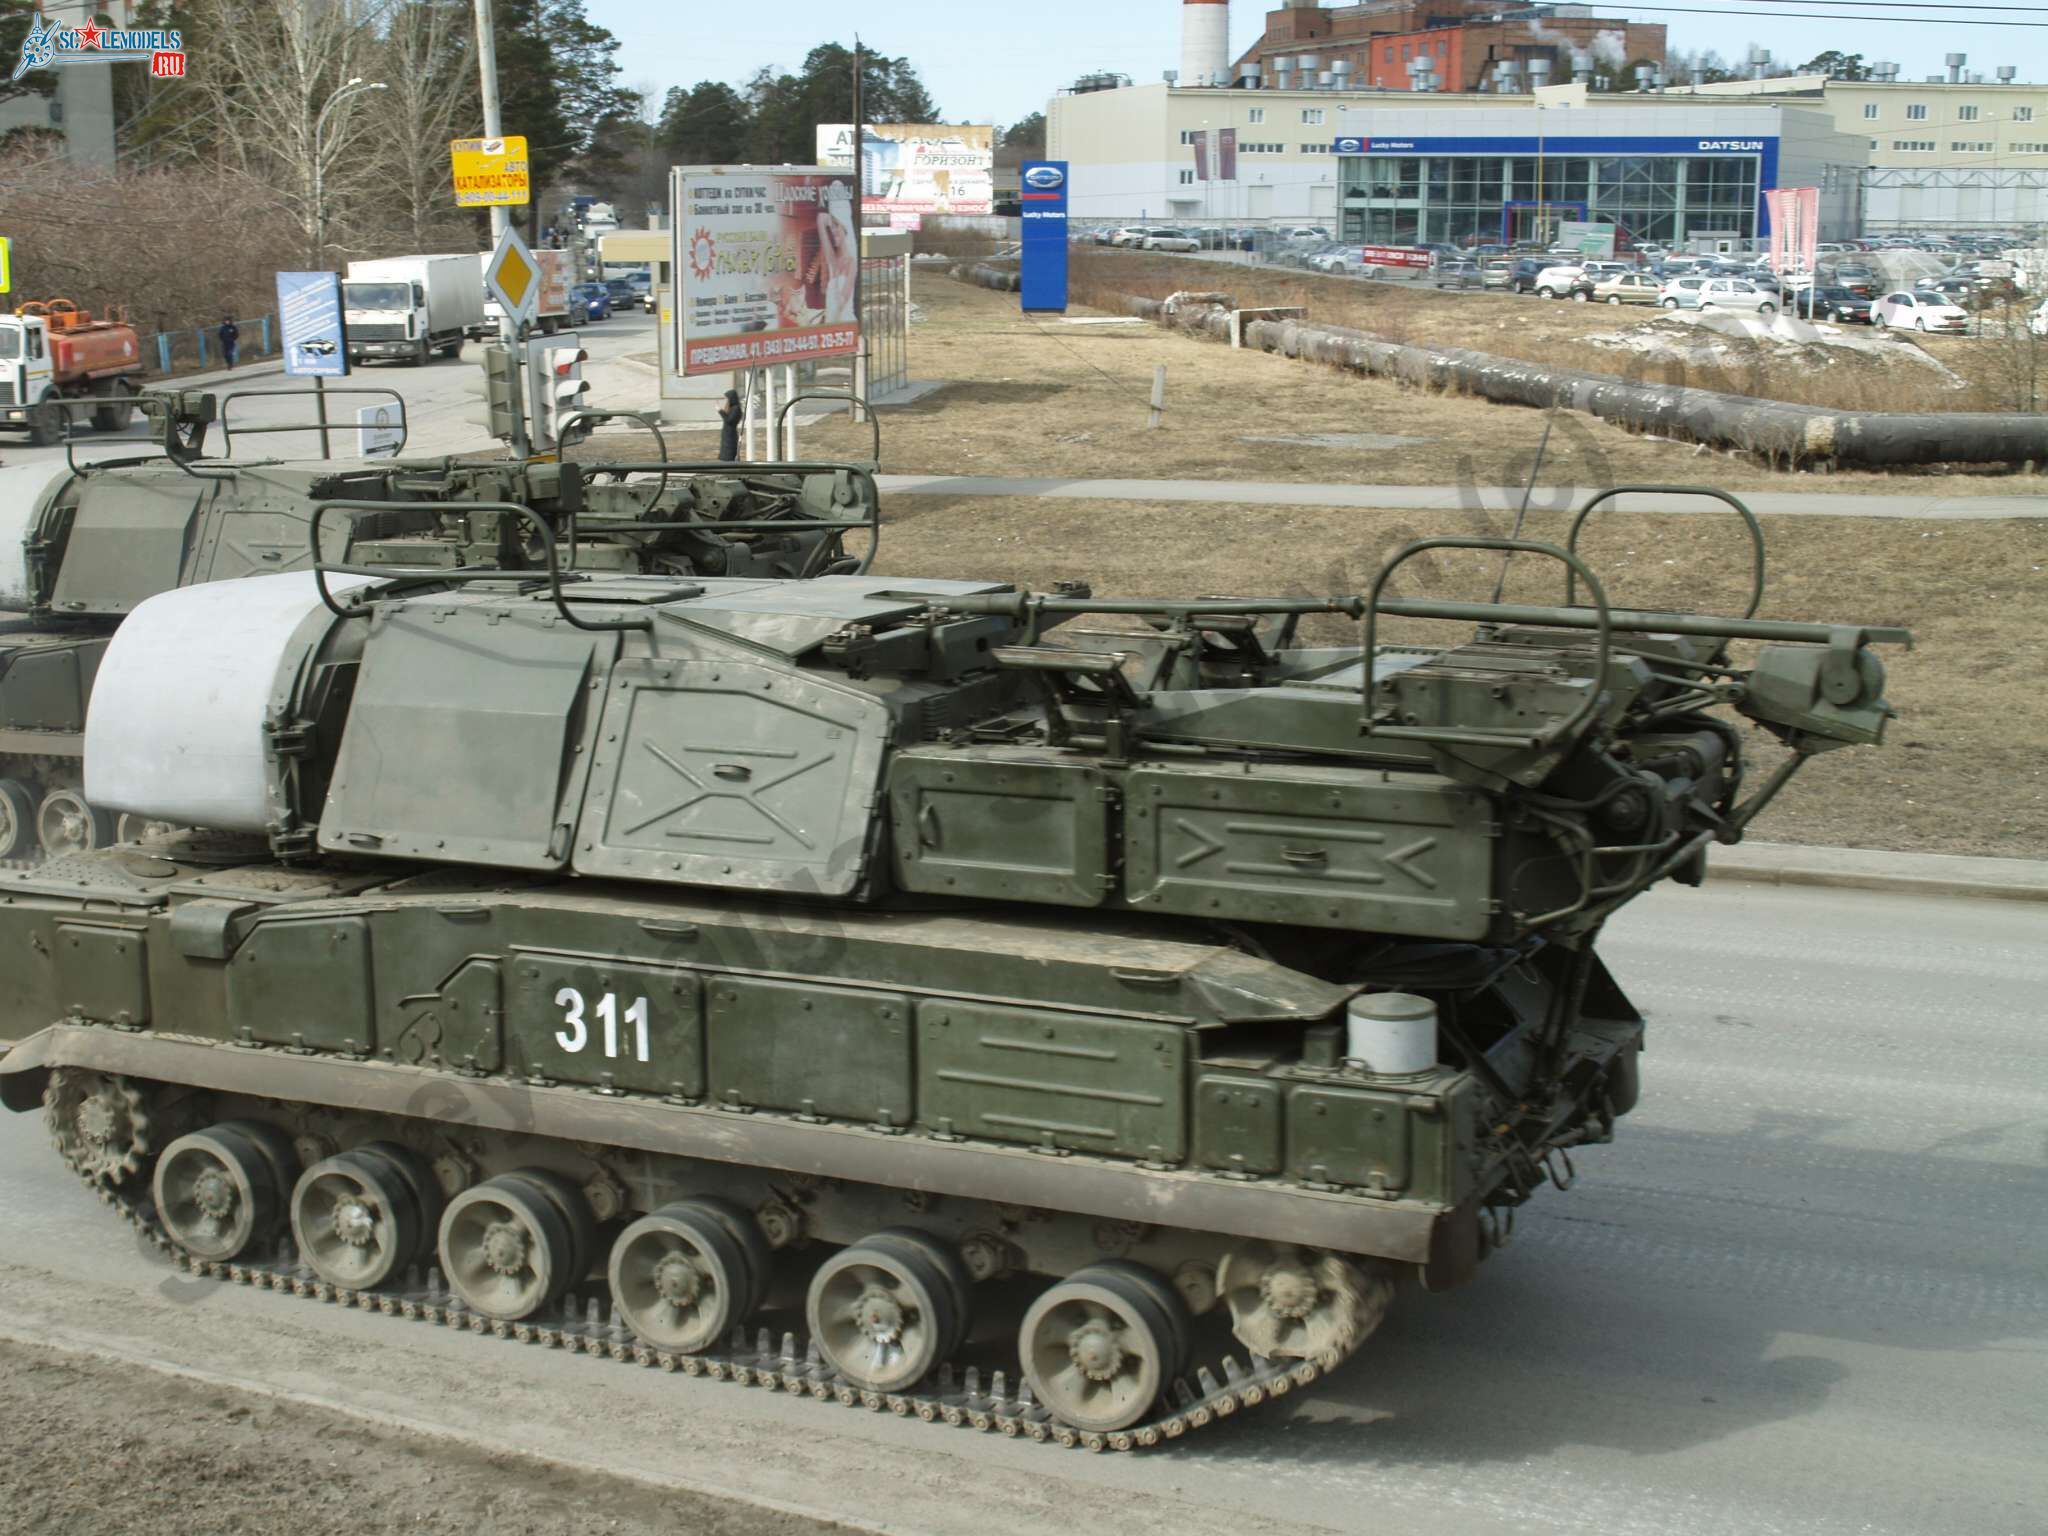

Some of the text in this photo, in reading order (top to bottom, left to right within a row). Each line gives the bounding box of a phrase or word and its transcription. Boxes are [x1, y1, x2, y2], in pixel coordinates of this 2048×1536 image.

[1697, 141, 1764, 151] DATSUN
[914, 156, 983, 166] ГОРИЗОНТ
[456, 173, 529, 190] КАТАЛИЗАТОРЫ
[554, 987, 650, 1062] 311
